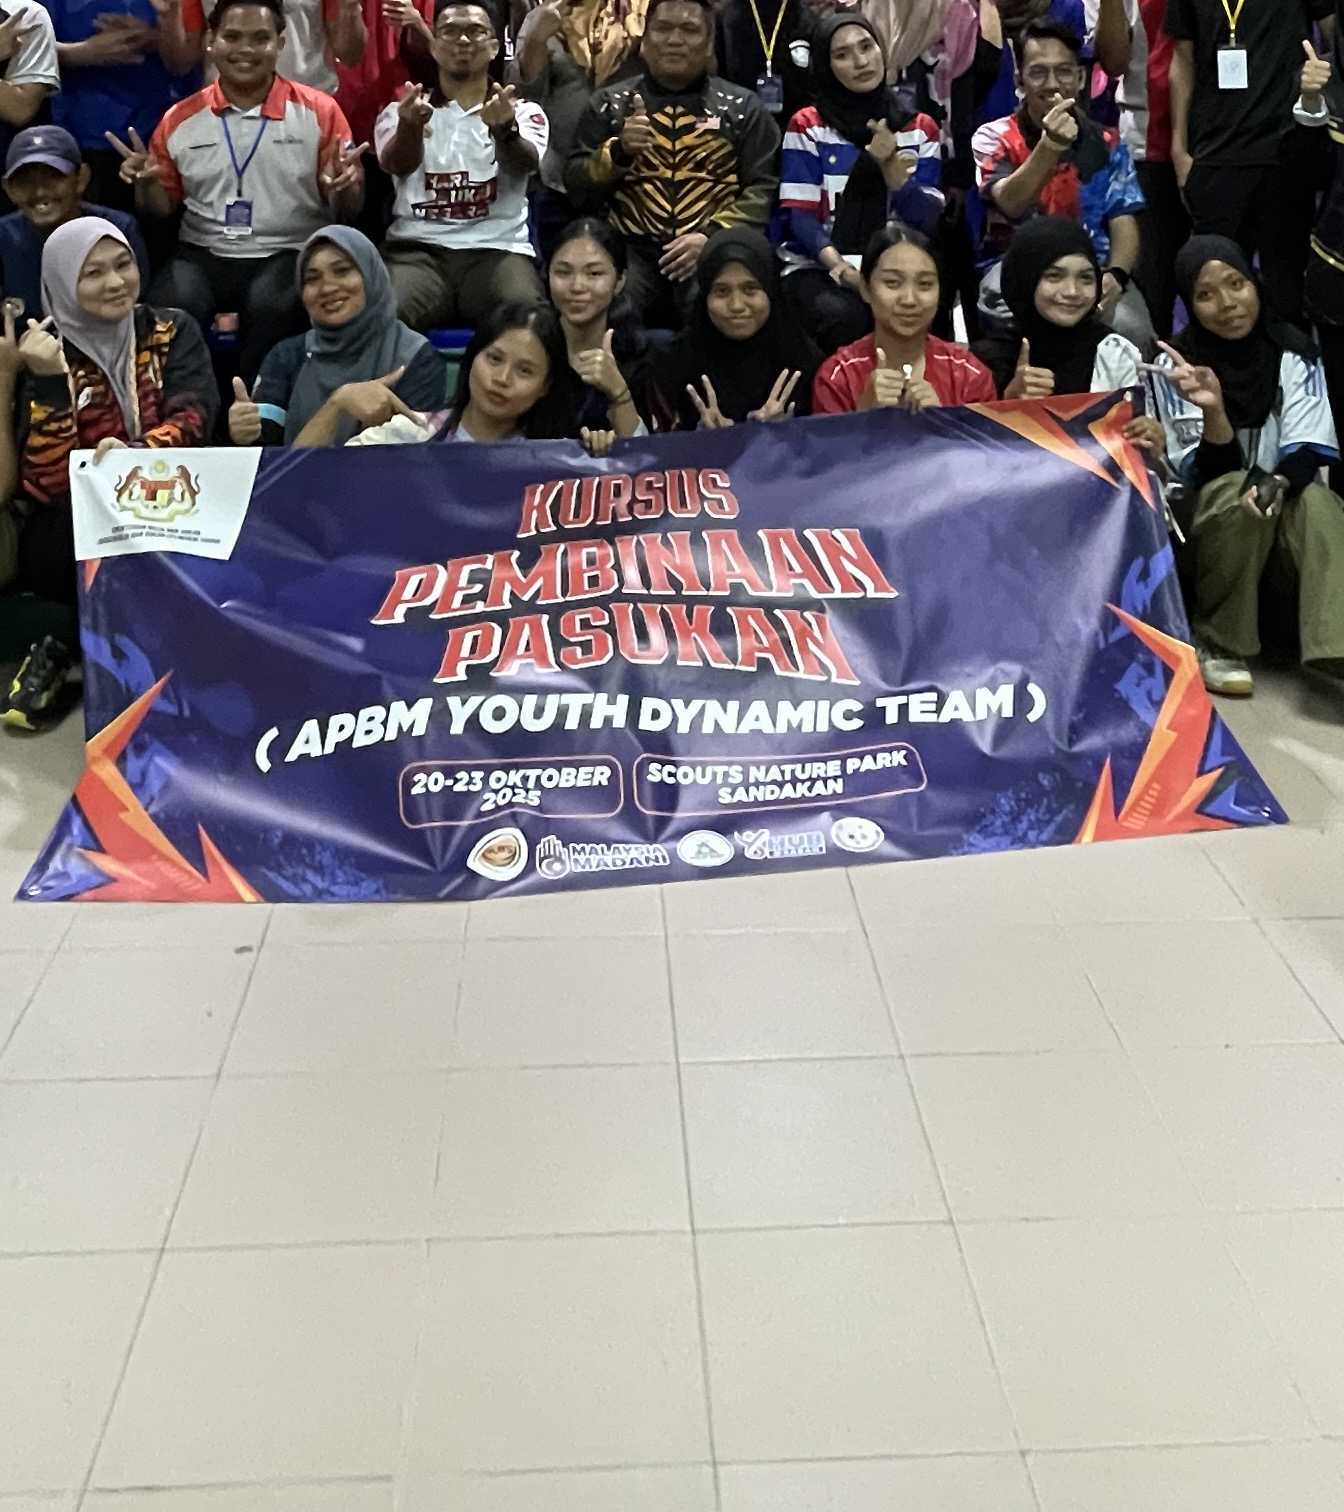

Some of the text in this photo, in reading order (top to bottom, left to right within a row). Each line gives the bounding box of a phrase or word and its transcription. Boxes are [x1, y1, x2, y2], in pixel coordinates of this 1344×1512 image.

[517, 468, 741, 539] KURSUS
[369, 528, 900, 625] PEMBINAAN
[433, 602, 862, 684] PASUKAN
[284, 697, 434, 763] APBM
[446, 692, 630, 736] YOUTH
[638, 696, 865, 735] DYNAMIC
[875, 683, 1016, 726] TEAM
[410, 765, 612, 796] 20-23 OKTOBER
[646, 749, 909, 786] SCOUTS NATURE PARK
[479, 789, 542, 813] 2025
[718, 778, 844, 805] SANDAKAN
[571, 852, 669, 872] MADANI
